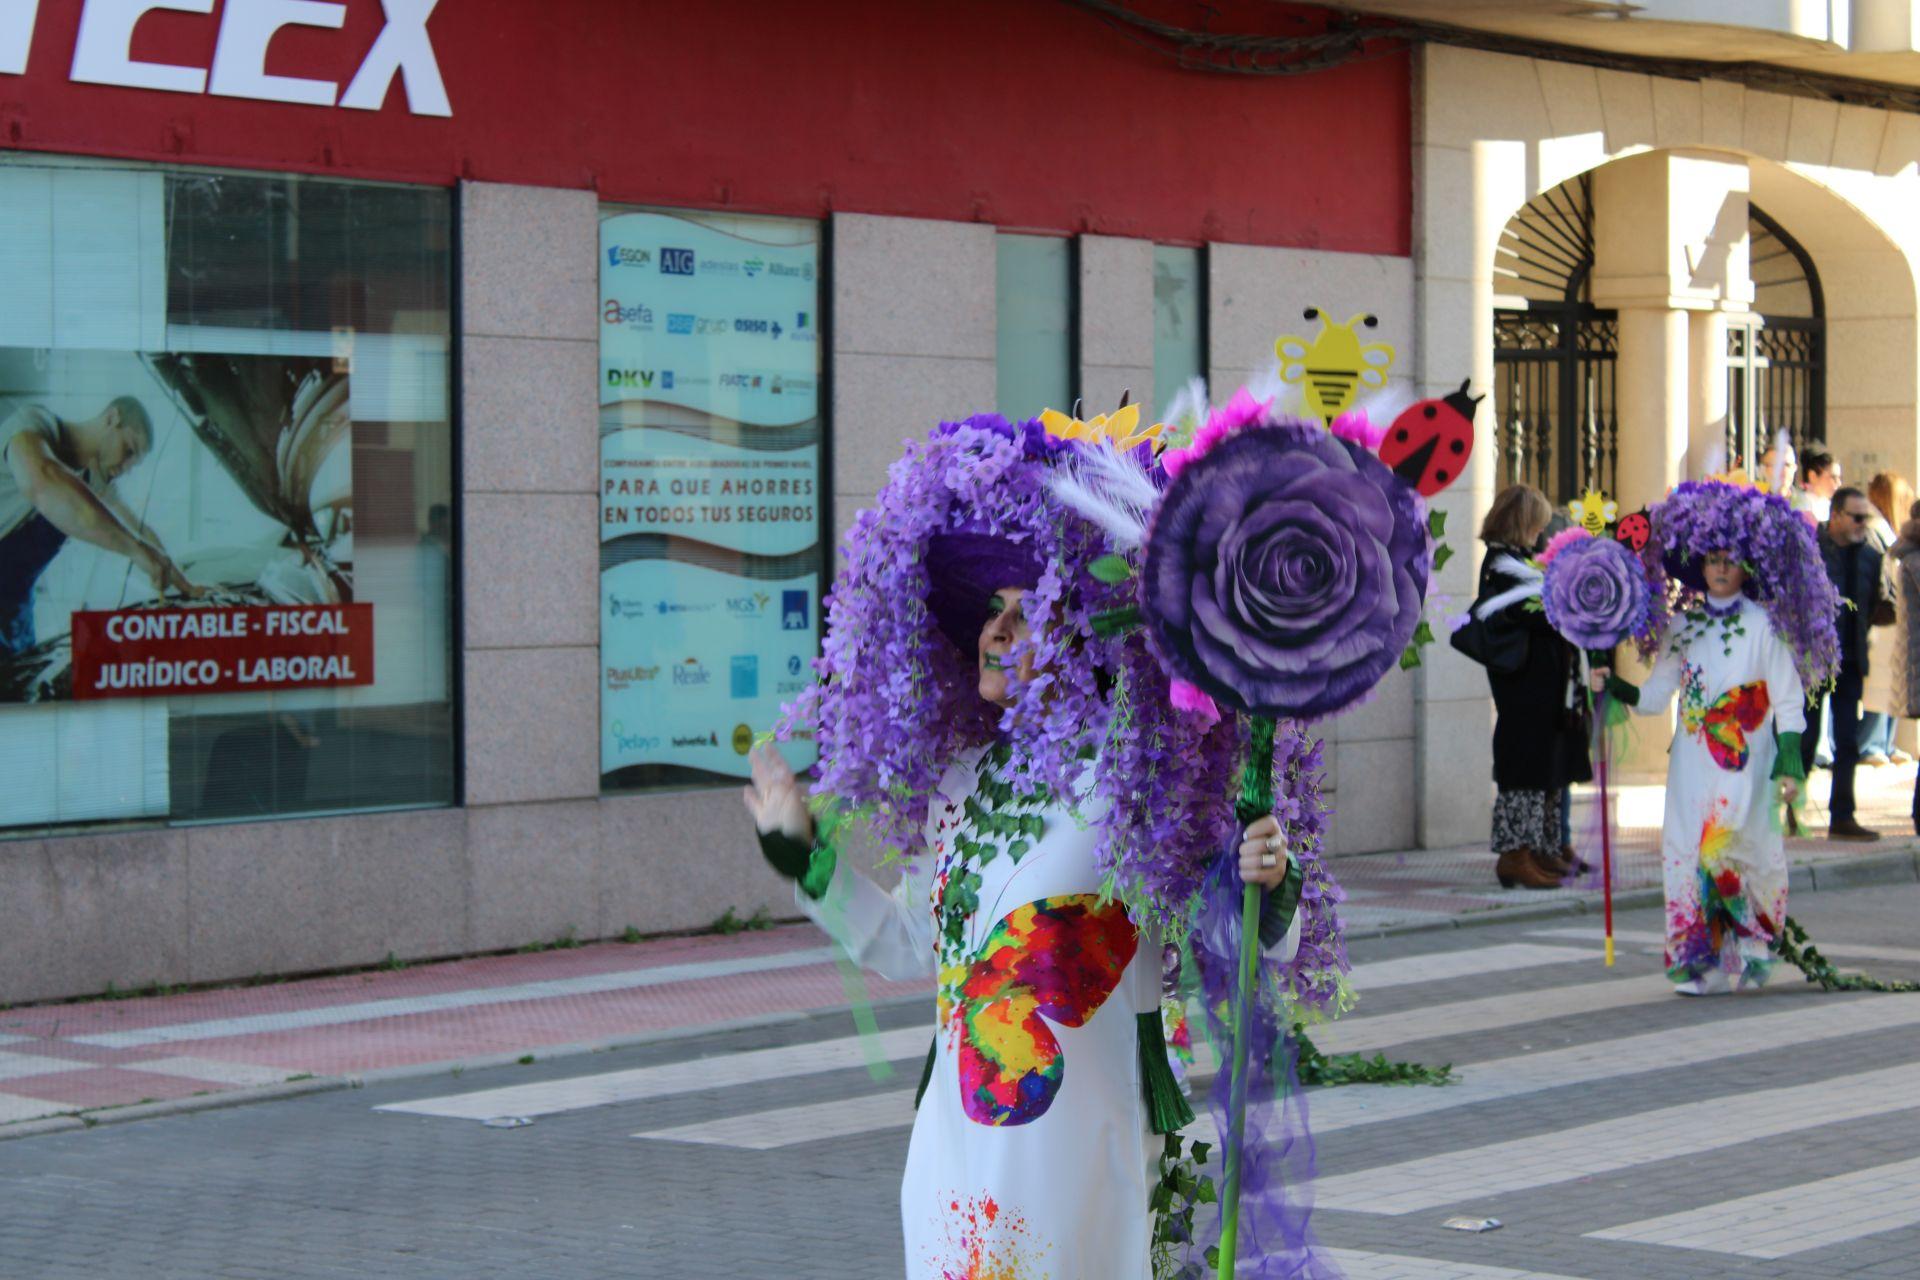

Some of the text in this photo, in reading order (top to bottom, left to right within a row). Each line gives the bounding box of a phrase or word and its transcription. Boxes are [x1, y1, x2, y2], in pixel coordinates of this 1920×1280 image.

[0, 0, 453, 117] EEX
[662, 250, 694, 274] AIG
[605, 299, 653, 324] asefa
[608, 368, 655, 388] DKV
[604, 479, 813, 496] PARA QUE AHORRES
[604, 506, 813, 523] EN TODOS TUS SEGUROS
[105, 613, 248, 643] CONTABLE
[266, 610, 349, 636] FISCAL
[94, 656, 219, 690] JURÍDICO
[238, 655, 356, 683] LABORAL
[672, 664, 711, 686] Reale
